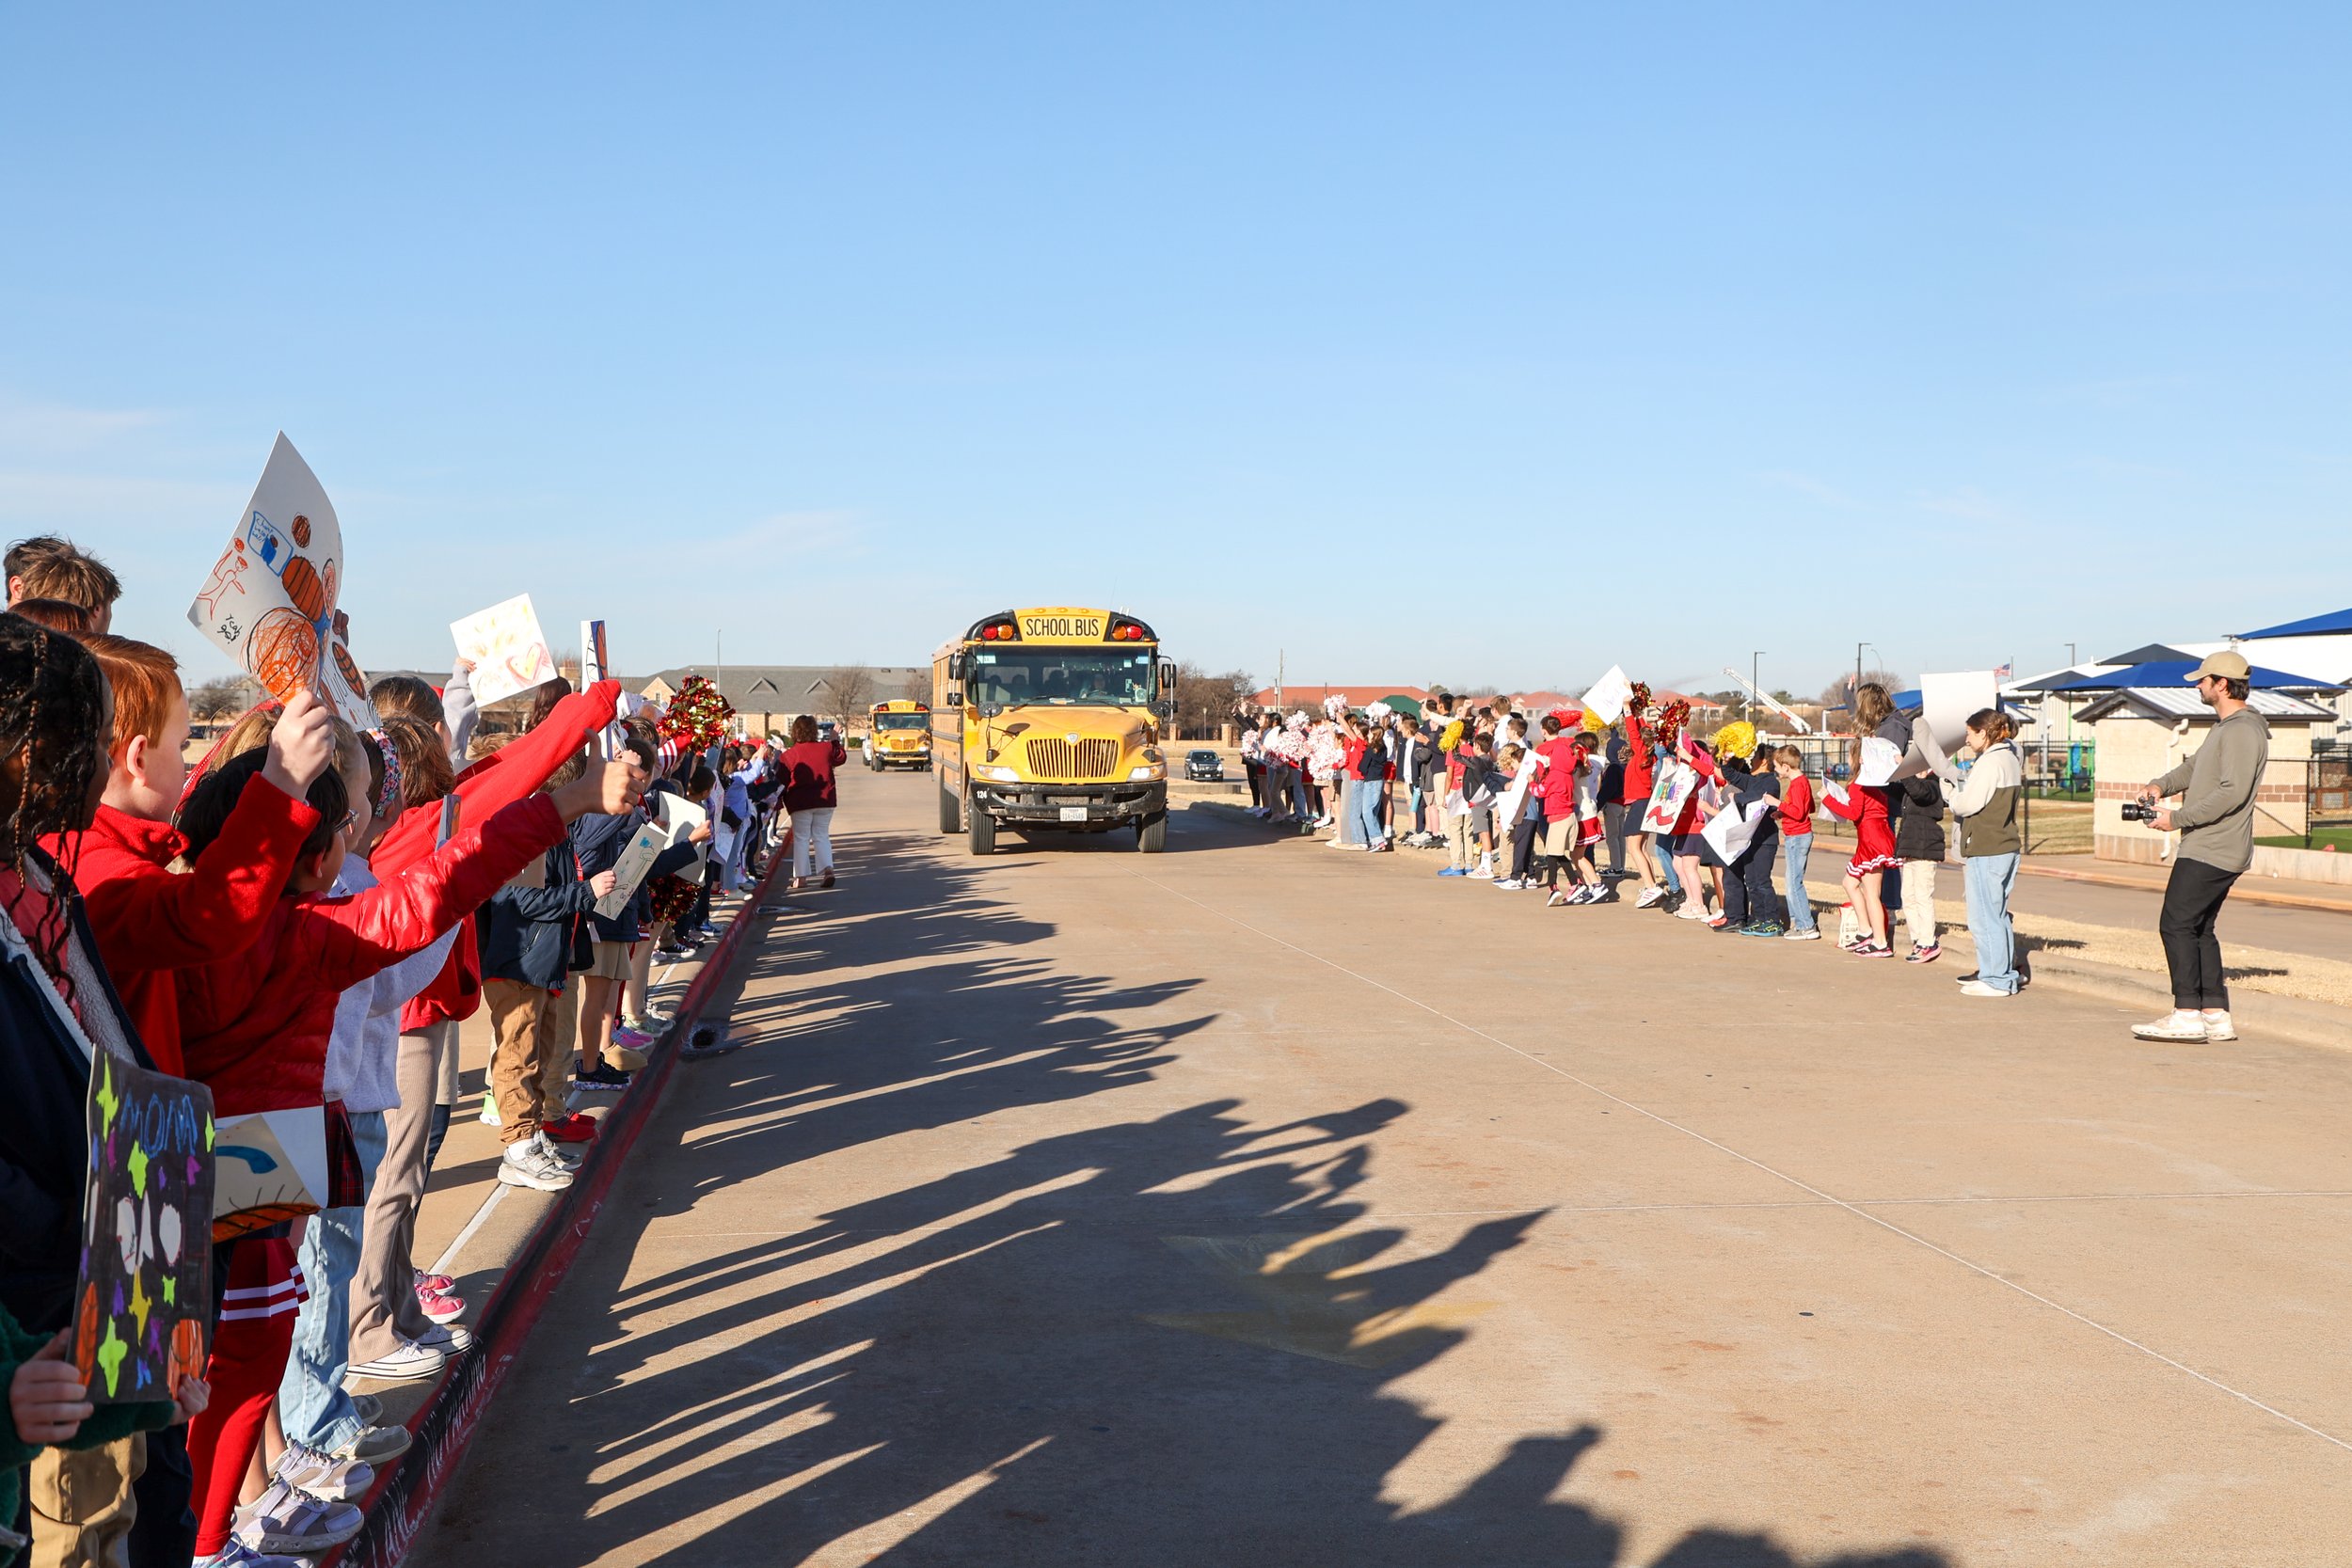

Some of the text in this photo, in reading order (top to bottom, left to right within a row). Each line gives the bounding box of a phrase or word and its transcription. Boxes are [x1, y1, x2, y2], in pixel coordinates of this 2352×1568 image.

[1025, 618, 1099, 637] SCHOOL BUS
[977, 790, 987, 799] 124
